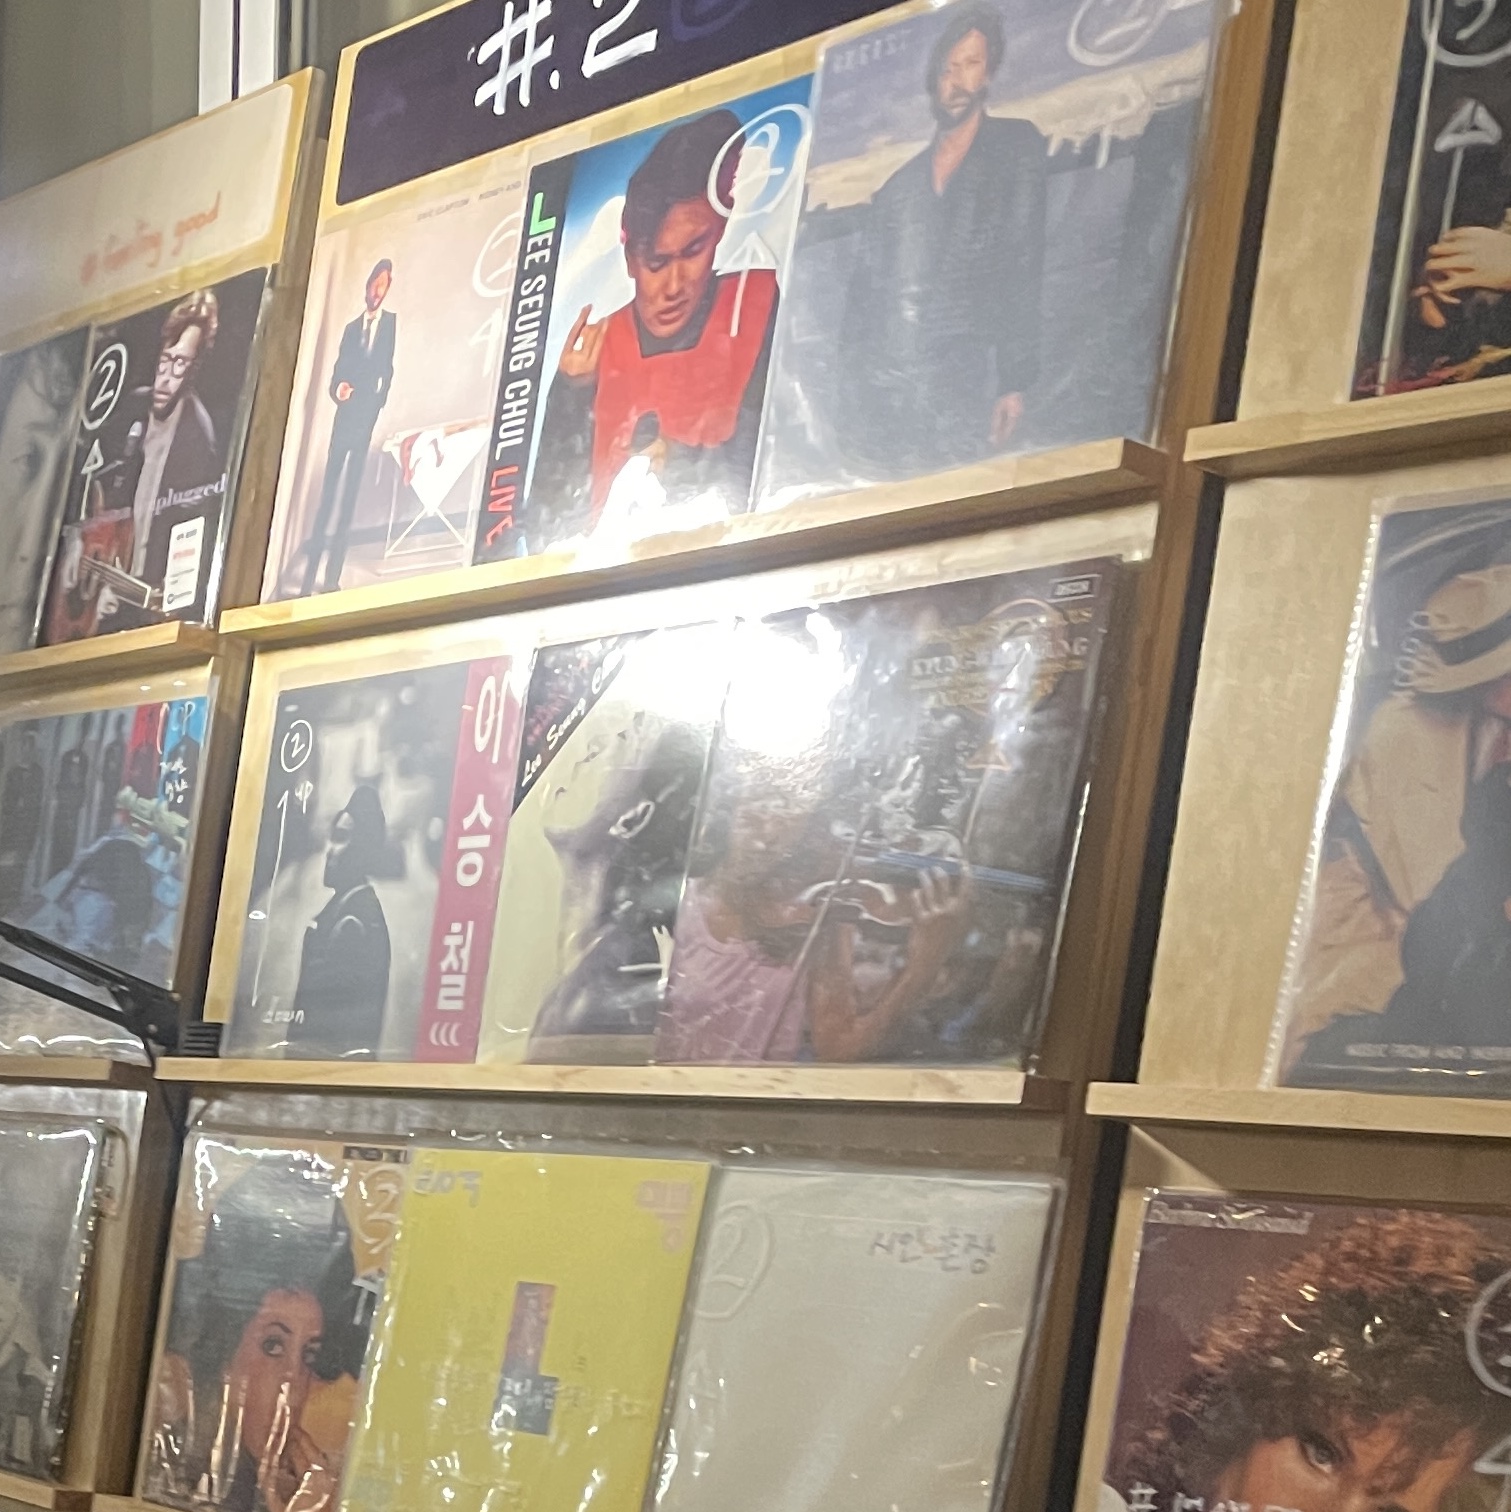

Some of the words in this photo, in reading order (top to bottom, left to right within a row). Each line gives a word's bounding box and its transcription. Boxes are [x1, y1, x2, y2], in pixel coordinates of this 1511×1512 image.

[522, 192, 556, 270] LEE
[506, 273, 548, 373] SEUNG
[492, 377, 534, 461] CHUL
[485, 464, 521, 548] LIVE
